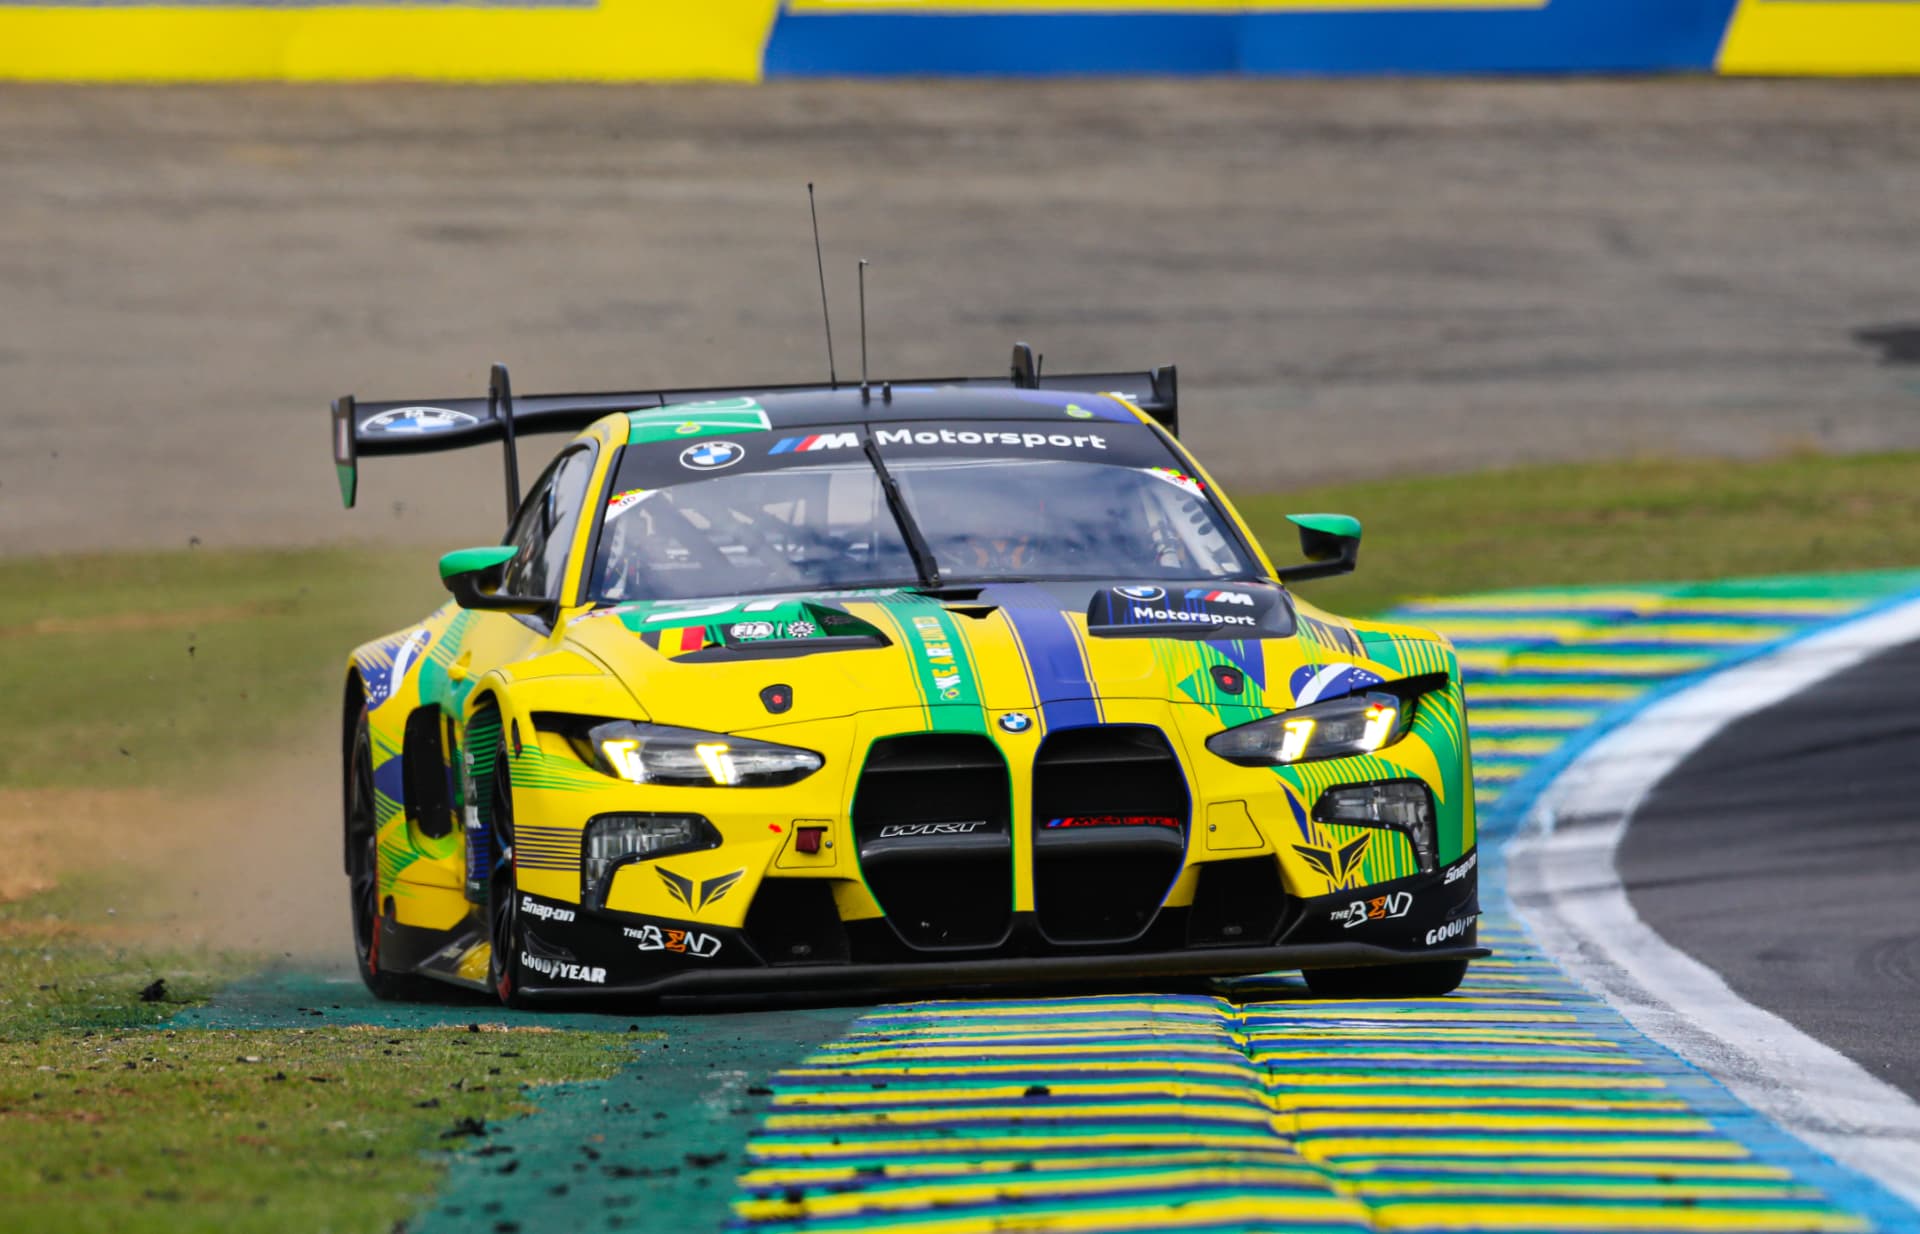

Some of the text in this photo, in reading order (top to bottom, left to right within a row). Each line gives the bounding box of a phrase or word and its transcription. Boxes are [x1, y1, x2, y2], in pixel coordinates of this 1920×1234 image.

[876, 429, 1107, 450] Motorsport
[1133, 607, 1256, 626] Motorsport
[733, 624, 770, 638] FIA
[924, 642, 956, 665] ARE
[932, 666, 962, 689] WE
[880, 820, 986, 838] WRT
[521, 896, 576, 922] Snap-on
[1330, 910, 1349, 921] THE
[623, 927, 642, 940] THE
[521, 951, 607, 984] GOODYEAR
